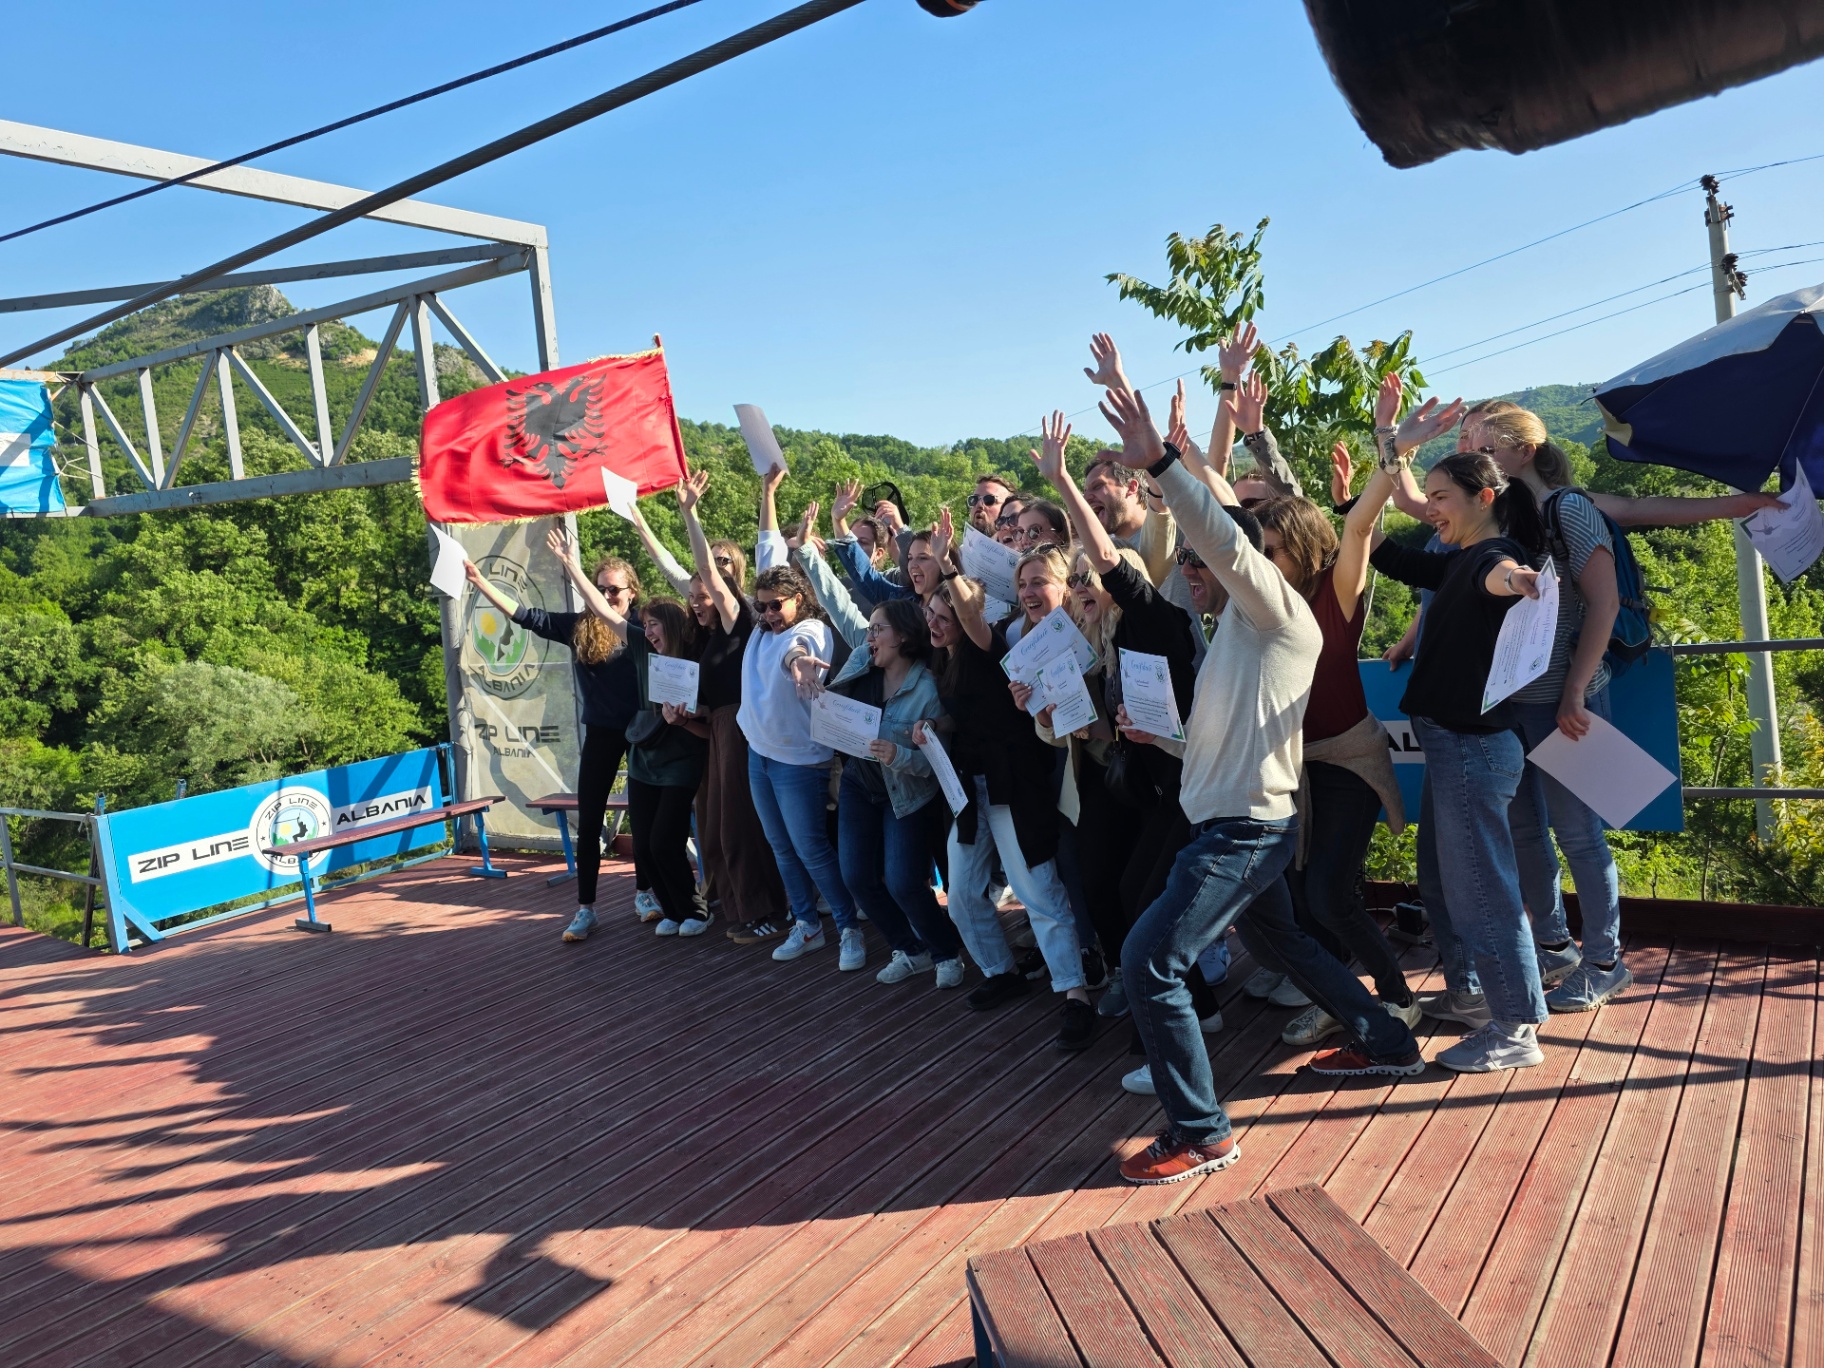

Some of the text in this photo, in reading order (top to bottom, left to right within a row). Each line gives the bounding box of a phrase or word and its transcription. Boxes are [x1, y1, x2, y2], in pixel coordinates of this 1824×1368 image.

[505, 725, 561, 743] LINE
[264, 797, 318, 820] ZIP LINE
[336, 794, 427, 826] ALBANIA
[138, 836, 250, 874] ZIP LINE
